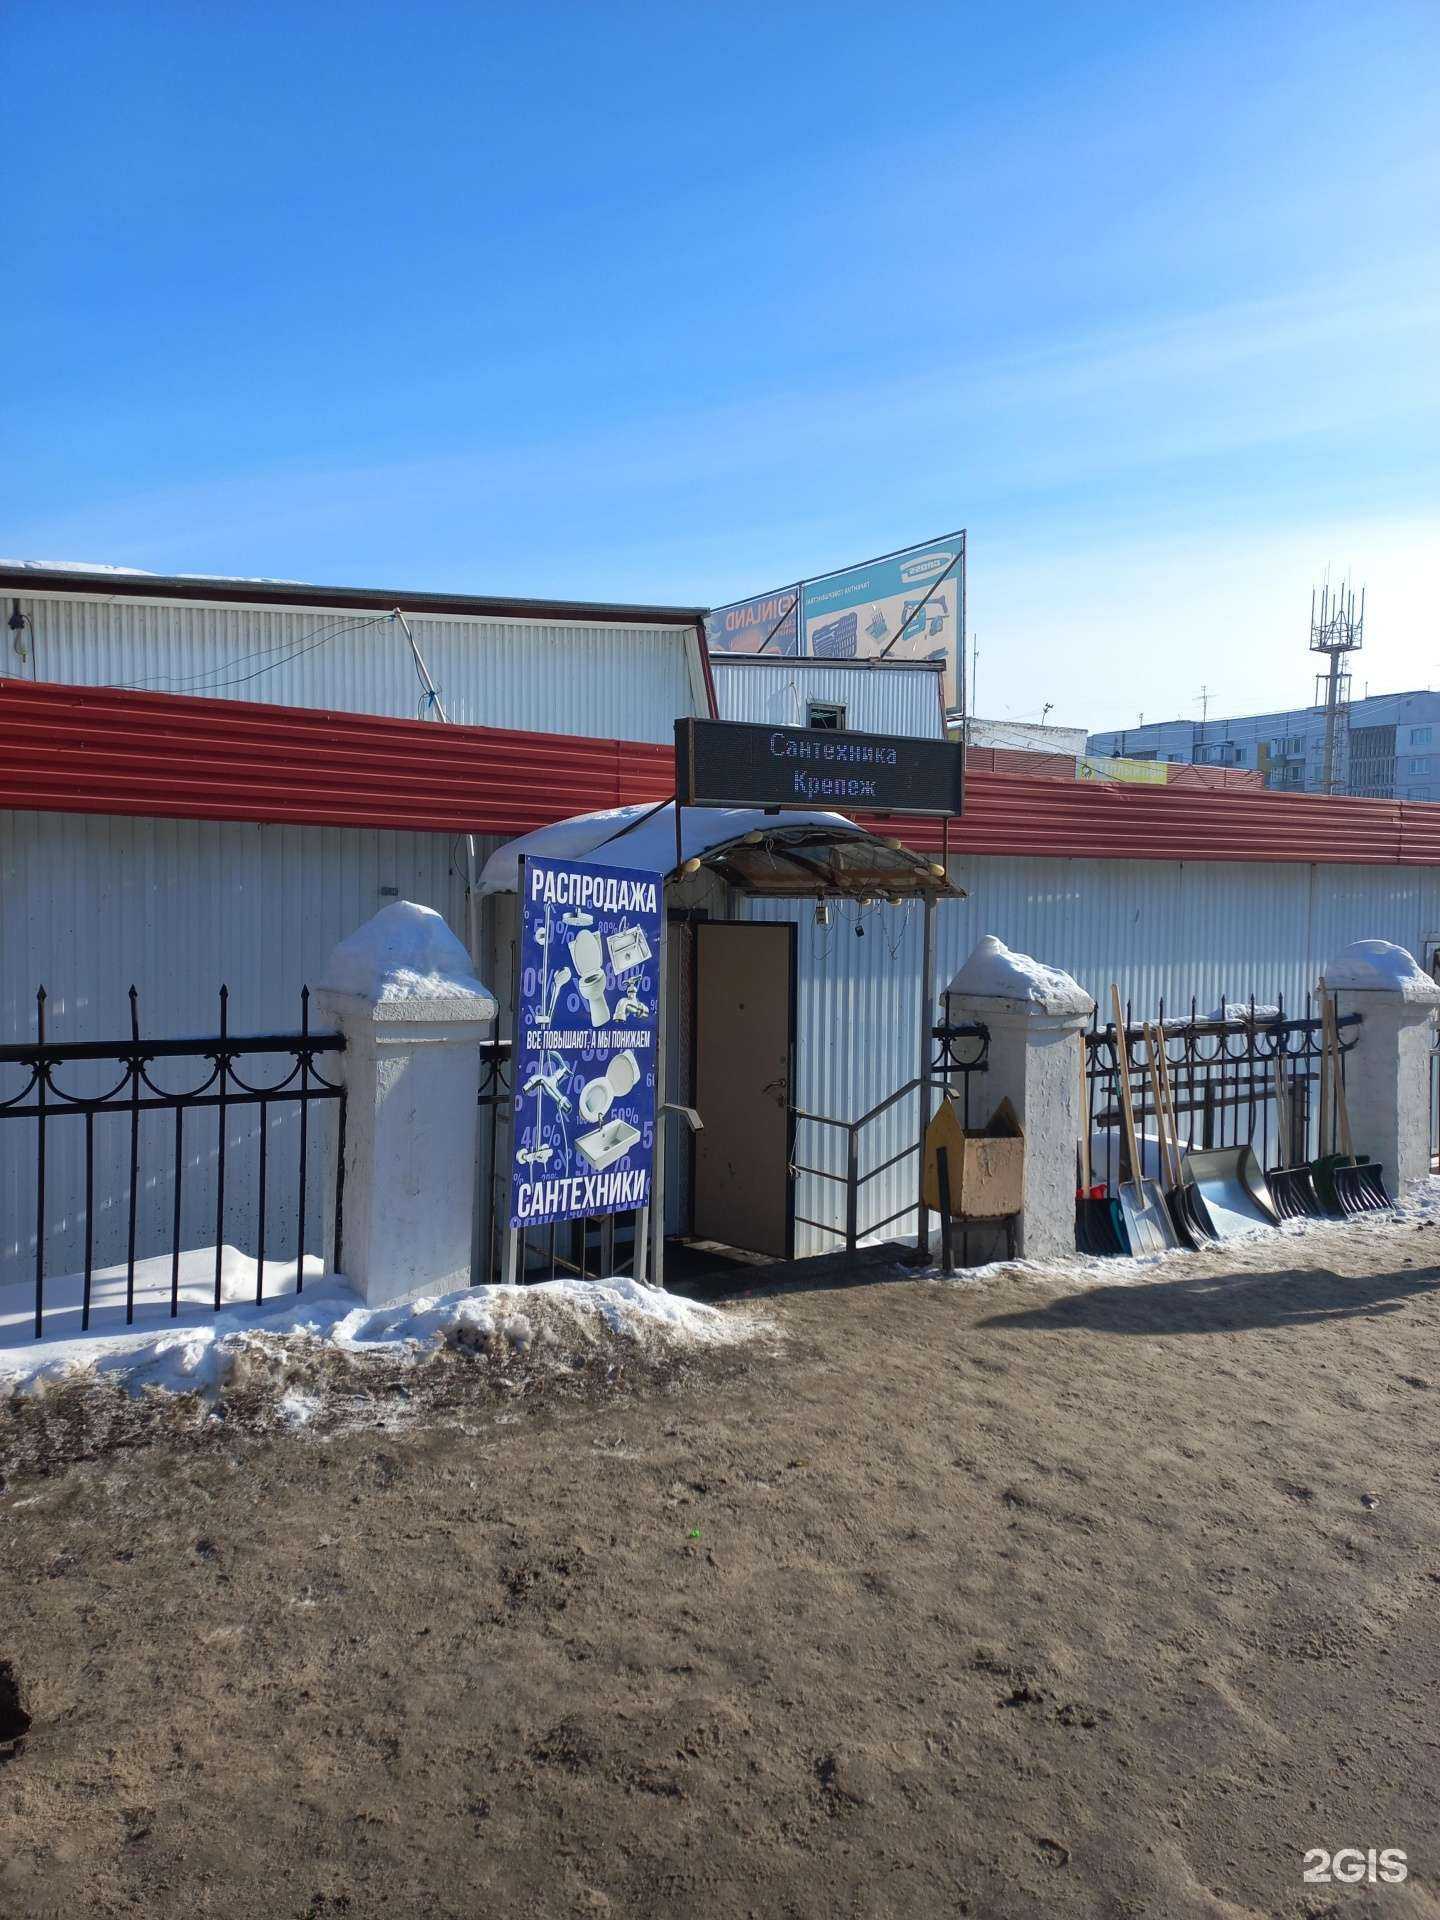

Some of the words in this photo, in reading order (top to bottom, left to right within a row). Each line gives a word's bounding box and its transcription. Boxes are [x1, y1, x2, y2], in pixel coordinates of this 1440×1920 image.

[770, 732, 897, 764] Сантехника
[794, 769, 876, 800] Крепеж
[531, 869, 657, 913] РАСПРОДАЖА
[526, 1031, 541, 1050] ВСЕ
[543, 1031, 590, 1050] ПОВЫШАЮТ,
[591, 1031, 597, 1048] А
[597, 1031, 611, 1048] МЫ
[612, 1031, 651, 1049] ПОНИЖАЕМ
[517, 1169, 646, 1218] САНТЕХНИКИ
